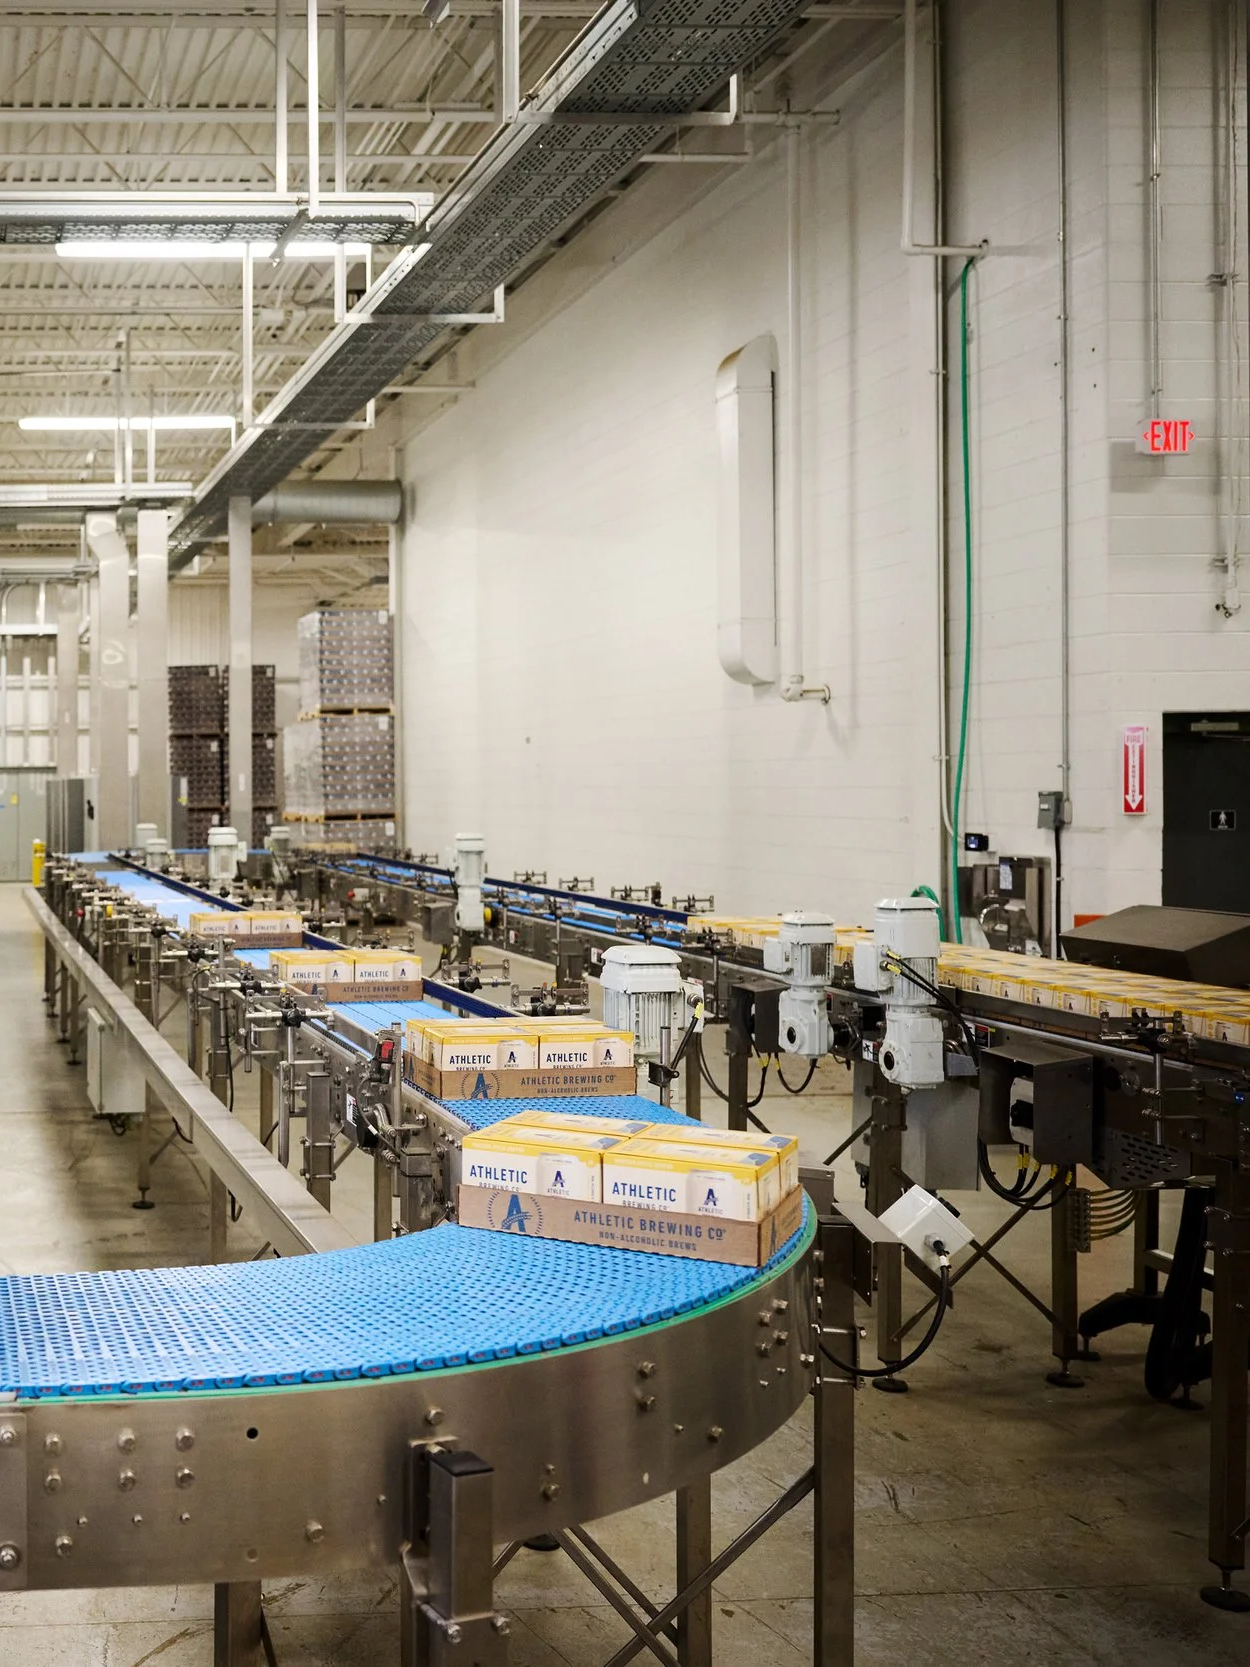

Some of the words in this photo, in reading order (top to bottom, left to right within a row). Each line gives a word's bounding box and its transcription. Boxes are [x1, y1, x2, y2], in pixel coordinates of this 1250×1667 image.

[1150, 421, 1190, 451] EXIT
[450, 1055, 491, 1064] ATHLETIC
[546, 1053, 588, 1062] ATHLETIC
[521, 1076, 560, 1085] ATHLETIC
[563, 1075, 602, 1084] BREWING
[470, 1165, 528, 1184] ATHLETIC
[547, 1188, 570, 1196] ATHLETIC
[612, 1182, 676, 1202] ATHLETIC
[698, 1207, 723, 1215] ATHLETIC
[574, 1210, 634, 1230] ATHLETIC
[640, 1216, 702, 1238] BREWING
[598, 1231, 665, 1247] NON-ALCOHOLIC
[668, 1240, 696, 1251] BREWS
